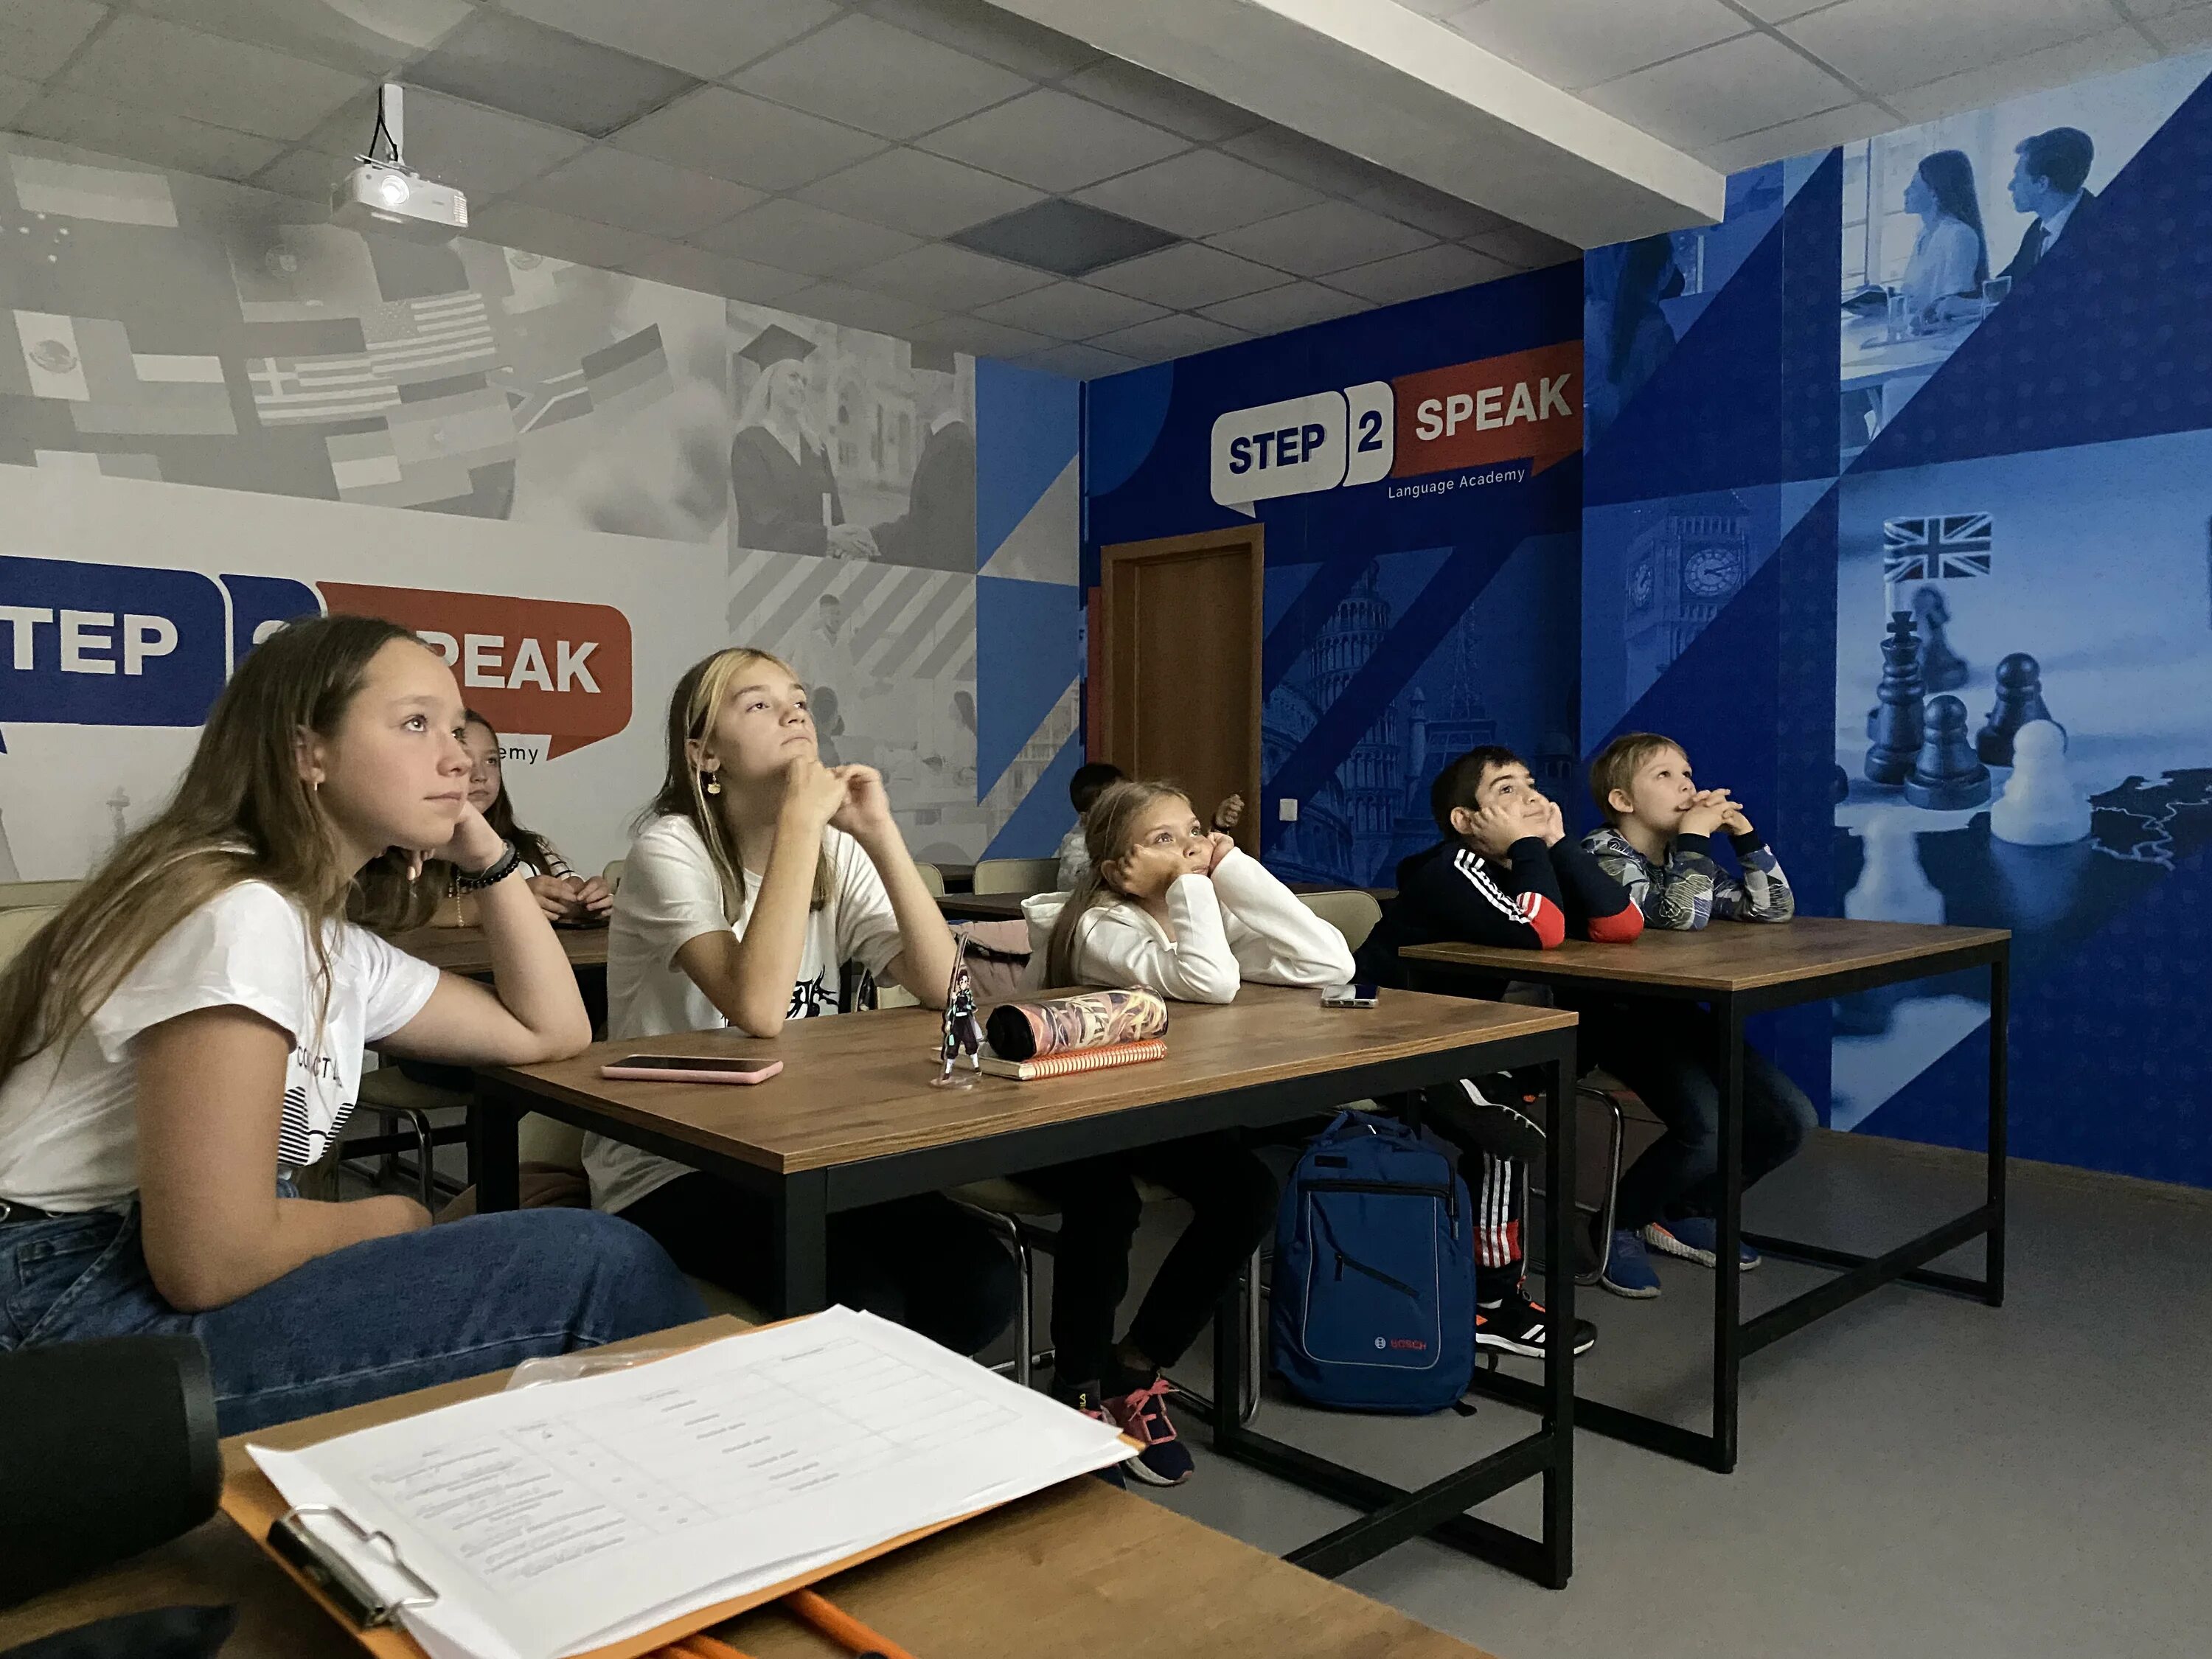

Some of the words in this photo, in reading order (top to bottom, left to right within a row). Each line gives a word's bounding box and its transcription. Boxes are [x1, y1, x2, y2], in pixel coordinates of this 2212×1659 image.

[1228, 422, 1326, 475] STEP
[1357, 410, 1383, 453] 2
[1416, 372, 1573, 442] SPEAK
[1388, 479, 1455, 498] Language
[1459, 468, 1526, 489] Academy
[0, 605, 179, 675] TEP
[415, 630, 602, 694] PEAK
[499, 747, 538, 765] emy
